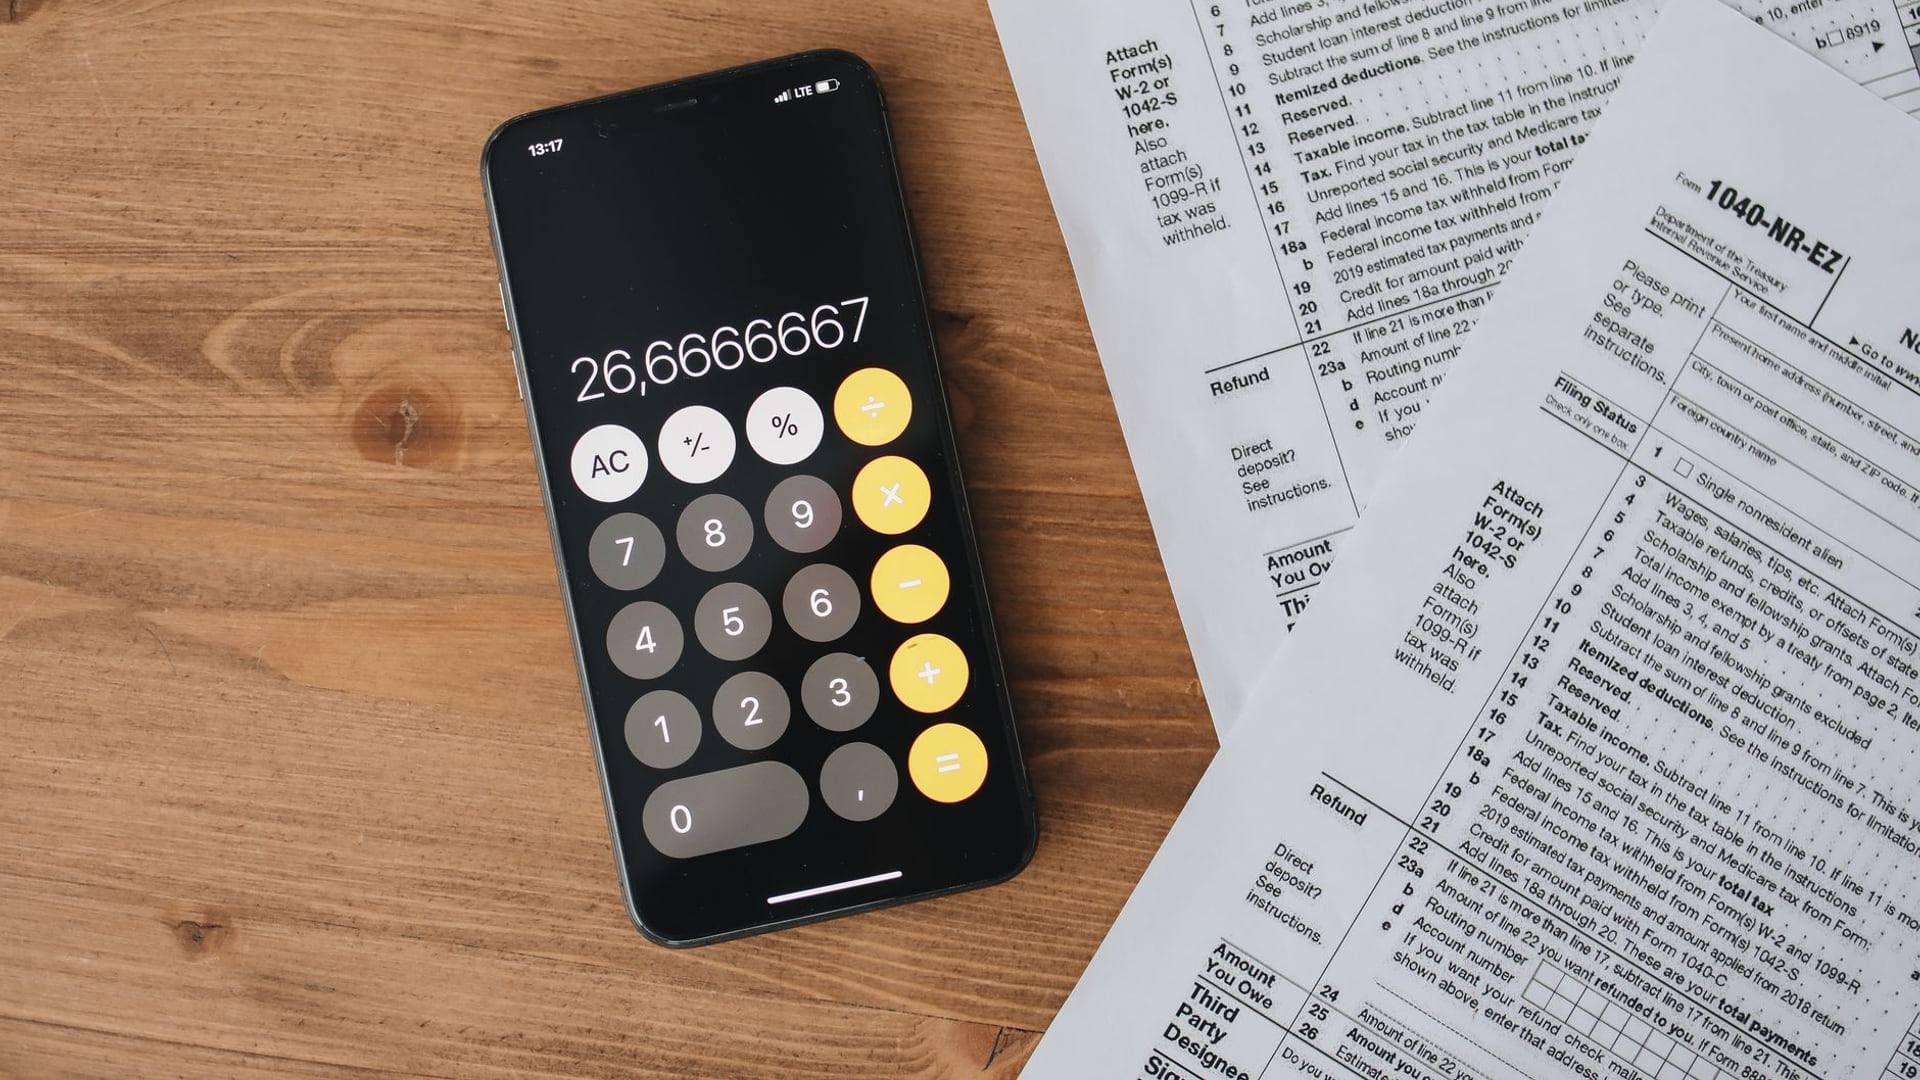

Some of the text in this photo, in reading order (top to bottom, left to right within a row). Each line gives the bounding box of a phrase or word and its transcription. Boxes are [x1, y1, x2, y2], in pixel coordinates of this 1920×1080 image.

[1767, 0, 1823, 21] 10, enter
[1107, 40, 1158, 64] Attach
[1815, 19, 1881, 49] b 8919
[1110, 54, 1171, 82] Form(s)
[1235, 7, 1580, 117] 11 Itemized deductions. See the instructions for
[794, 85, 813, 98] LTE
[1115, 77, 1168, 100] W-2 or
[1122, 92, 1176, 118] 1042-S
[1128, 119, 1168, 137] here.
[1241, 96, 1351, 136] 12 Reserved.
[1255, 55, 1633, 175] 14 Taxable income. Subtract line 11 from line 10. If line
[529, 139, 562, 156] 13:17
[1136, 137, 1167, 154] Also
[1141, 150, 1186, 173] attach
[1145, 164, 1202, 191] Form(s)
[1152, 177, 1220, 208] 1099-R if
[1157, 203, 1215, 227] tax was
[1163, 215, 1230, 245] withheld.
[1676, 172, 1842, 273] Form 1040-NR-EZ
[1293, 213, 1533, 295] 19 2019 estimated tax payments and
[1654, 206, 1787, 292] Department of the Treasury
[1688, 240, 1729, 269] Revenue
[1732, 267, 1767, 293] Service
[1604, 293, 1630, 316] See
[1613, 280, 1662, 316] or type.
[1623, 260, 1704, 317] Please print
[571, 296, 870, 403] 26,6666667
[1594, 312, 1653, 353] separate
[1584, 325, 1665, 384] instructions.
[1210, 367, 1269, 395] Refund
[1555, 376, 1636, 433] Filing Status
[592, 450, 629, 478] AC
[772, 414, 797, 438] %
[1671, 396, 1776, 465] Foreign country name
[1231, 439, 1272, 461] Direct
[1238, 449, 1294, 477] deposit?
[1243, 479, 1269, 494] See
[1247, 480, 1330, 511] instructions.
[1492, 481, 1543, 517] Attach
[1483, 496, 1541, 540] Form(s)
[1655, 447, 1842, 568] 1 Single nonresident alien
[616, 537, 633, 566] 7
[704, 519, 725, 546] 8
[792, 500, 813, 528] 9
[1466, 530, 1516, 568] 1042-S
[1474, 512, 1524, 550] W-2 or
[1268, 540, 1331, 571] Amount
[1453, 546, 1488, 577] here.
[1635, 475, 1917, 656] 3 Wages, salaries, tips, etc. Attach Form(s)
[1270, 570, 1305, 587] You
[1442, 564, 1474, 589] Also
[1423, 596, 1477, 638] Form(s)
[1433, 583, 1477, 615] attach
[636, 626, 656, 652] 4
[723, 607, 743, 635] 5
[811, 589, 832, 617] 6
[1416, 614, 1481, 660] 1099-R if
[1404, 630, 1458, 671] tax was
[1395, 649, 1455, 693] withheld.
[655, 716, 669, 742] 1
[741, 697, 762, 726] 2
[830, 678, 850, 706] 3
[671, 805, 691, 833] 0
[1310, 784, 1367, 825] Refund
[1478, 727, 1774, 916] 17 Add lines 15 and 16. This is your total tax
[1274, 843, 1313, 874] Direct
[1256, 875, 1281, 897] See
[1266, 861, 1321, 899] deposit?
[1246, 888, 1321, 944] instructions.
[1403, 882, 1528, 965] b Routing number
[1207, 957, 1272, 1008] You Owe
[1213, 943, 1277, 988] Amount
[1191, 982, 1239, 1022] Third
[1176, 1002, 1227, 1044] Party
[1163, 1022, 1249, 1079] Designee
